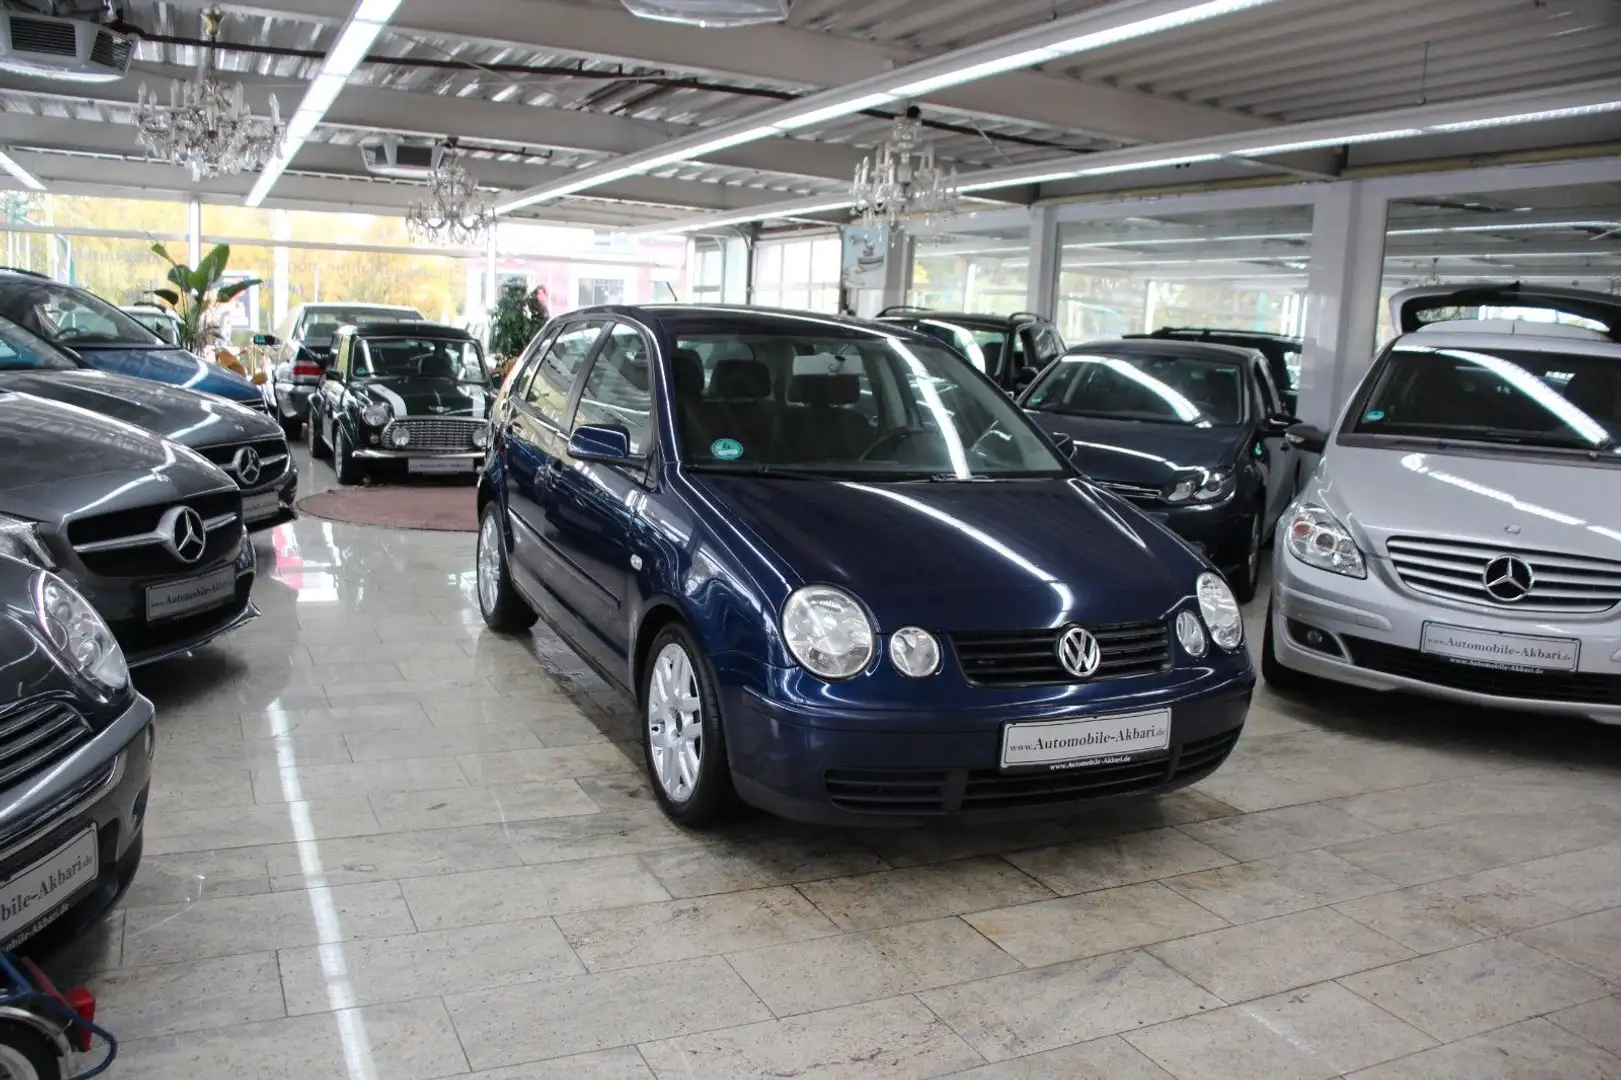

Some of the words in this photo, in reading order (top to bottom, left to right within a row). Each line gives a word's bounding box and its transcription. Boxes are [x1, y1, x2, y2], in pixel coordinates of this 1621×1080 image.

[1060, 628, 1099, 676] VW
[1427, 638, 1573, 662] www.Automobile-Akbari.de
[1009, 725, 1166, 752] www.Automobile-Akbari.de
